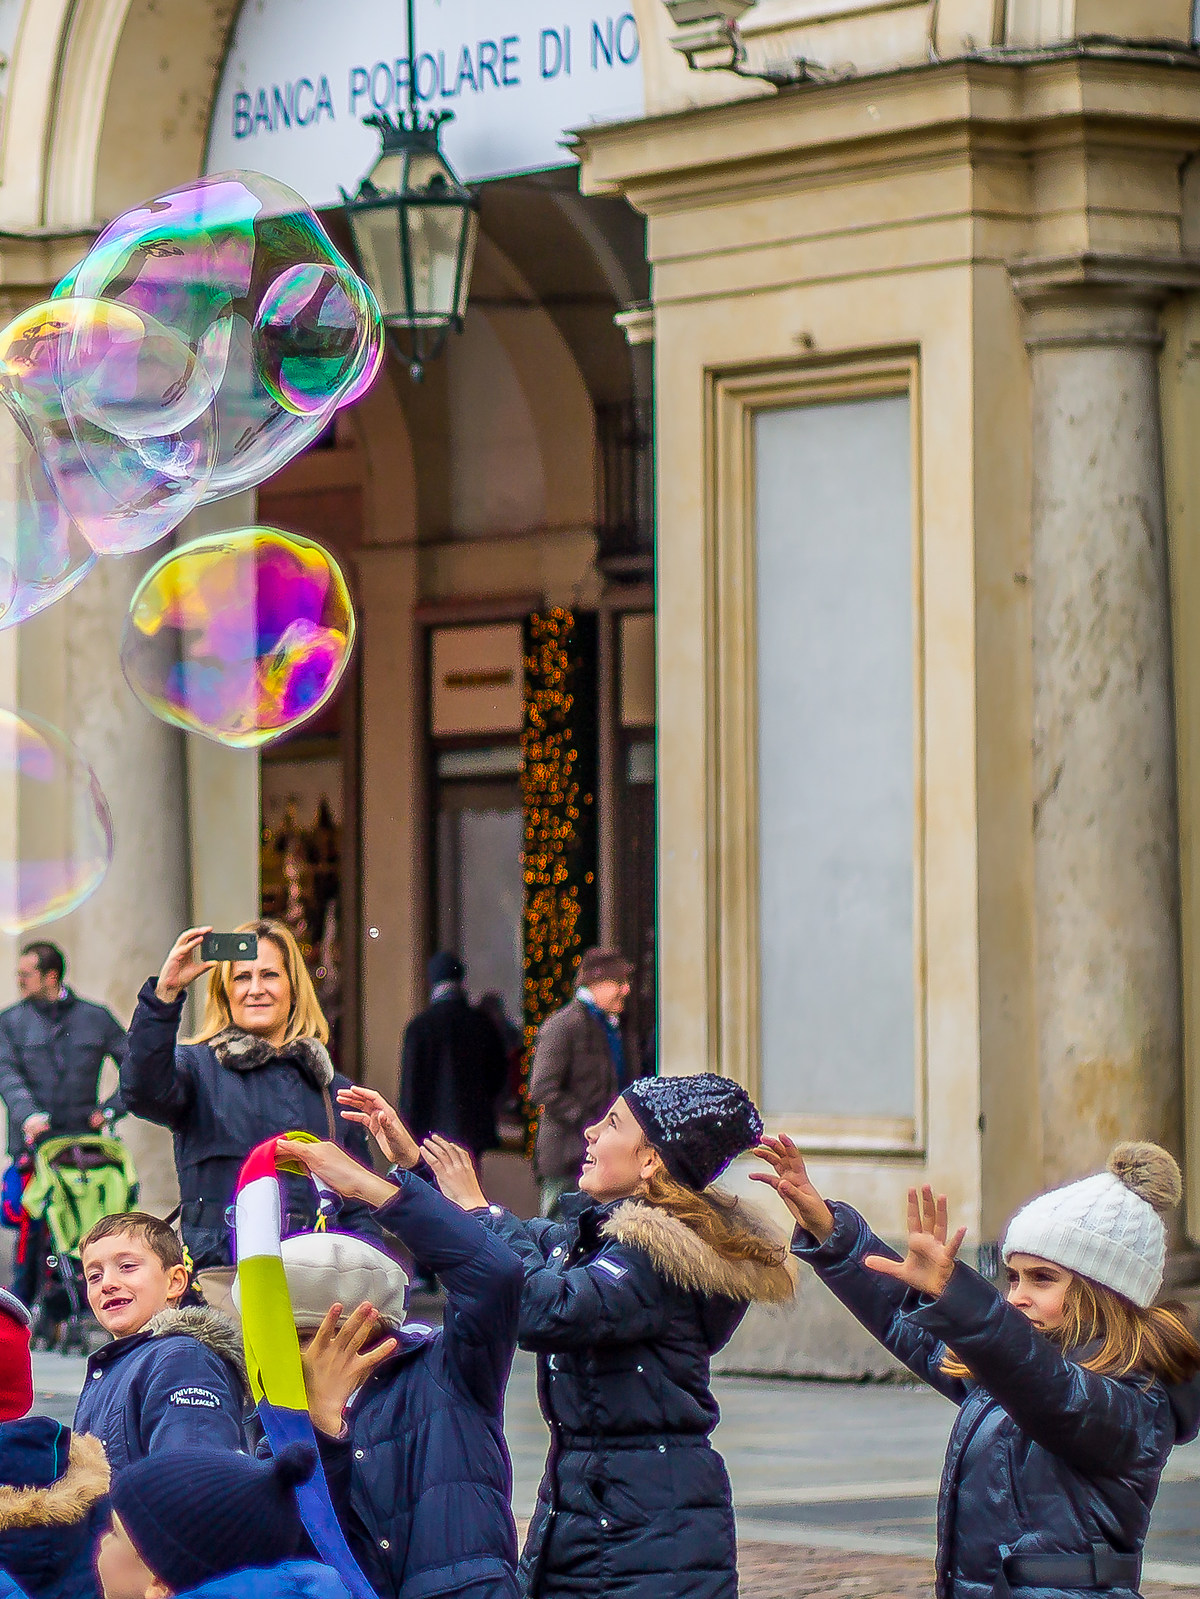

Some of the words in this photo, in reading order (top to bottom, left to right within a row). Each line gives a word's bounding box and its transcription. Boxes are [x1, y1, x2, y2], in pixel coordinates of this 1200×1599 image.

[233, 74, 335, 139] BANCA
[349, 35, 521, 116] POPOLARE
[540, 25, 571, 80] DI
